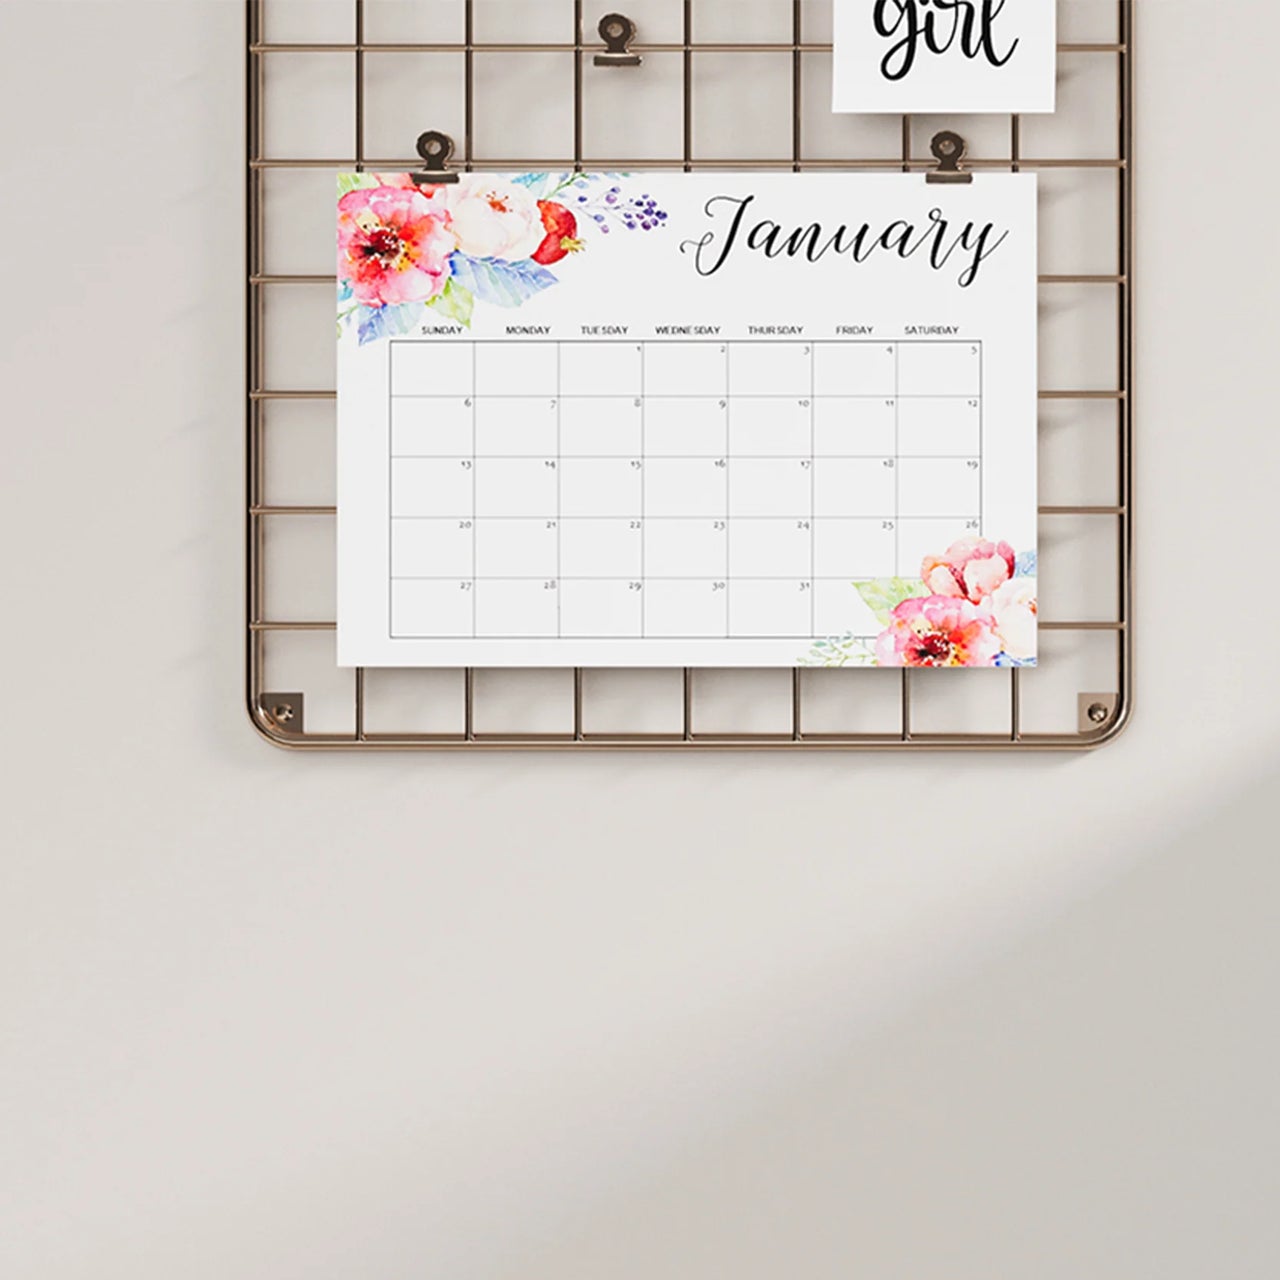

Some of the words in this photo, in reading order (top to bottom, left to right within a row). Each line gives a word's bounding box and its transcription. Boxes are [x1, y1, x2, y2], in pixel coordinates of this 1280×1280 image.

[679, 194, 1009, 289] January
[422, 326, 462, 335] SUNDAY
[506, 326, 551, 335] MONDAY
[581, 326, 629, 335] TUESDAY
[655, 326, 721, 335] WEDNESDAY
[748, 326, 804, 335] THURSDAY
[836, 326, 874, 335] FRIDAY
[904, 326, 959, 335] SATURDAY
